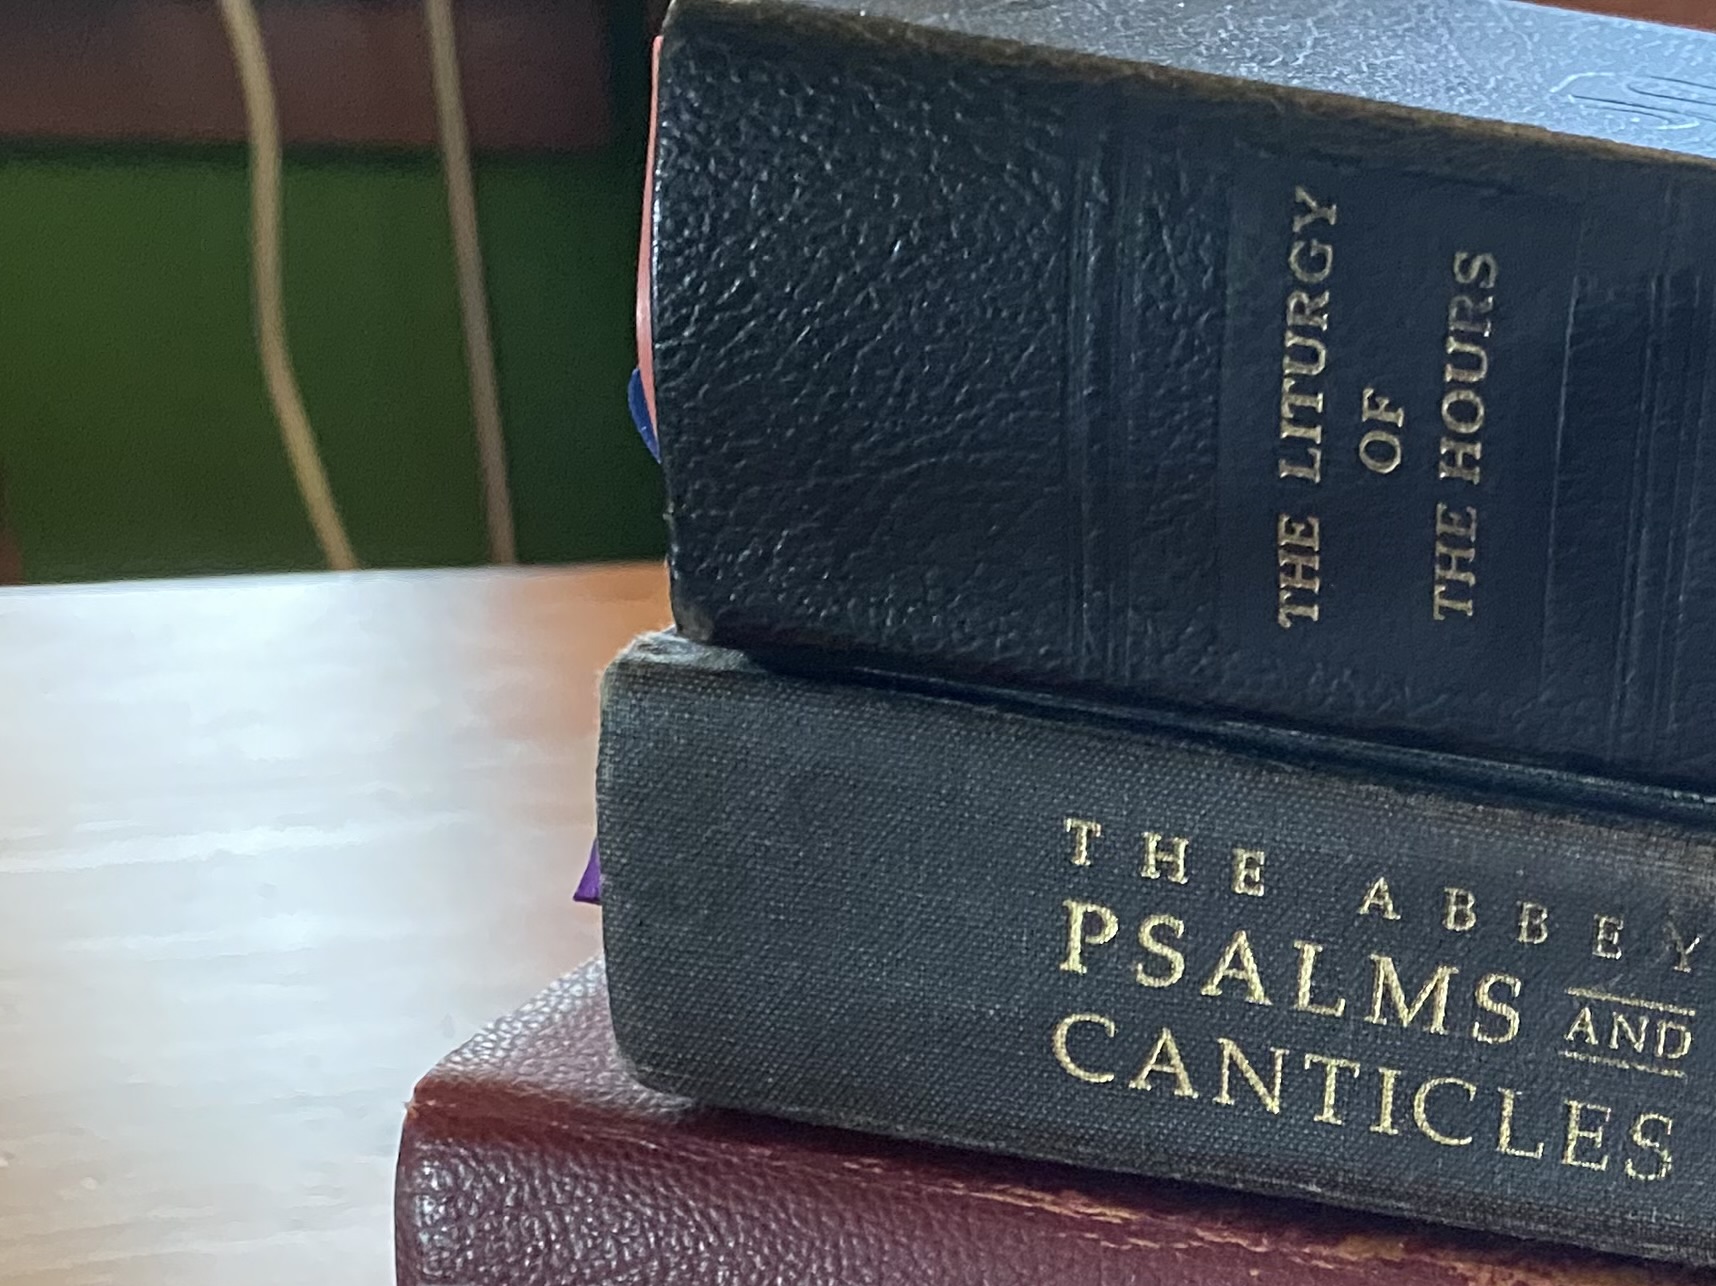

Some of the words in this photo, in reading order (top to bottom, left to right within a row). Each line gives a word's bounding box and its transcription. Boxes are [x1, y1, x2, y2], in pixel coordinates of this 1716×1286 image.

[1279, 186, 1337, 484] LITURGY
[1439, 251, 1498, 485] HOURS
[1358, 387, 1405, 475] OF
[1277, 514, 1320, 628] THE
[1433, 502, 1477, 620] THE
[1064, 817, 1265, 897] THE
[1358, 876, 1701, 973] ABBEY
[1060, 899, 1522, 1044] PSALMS
[1564, 1006, 1693, 1060] AND
[1051, 1013, 1673, 1182] CANTICLES
